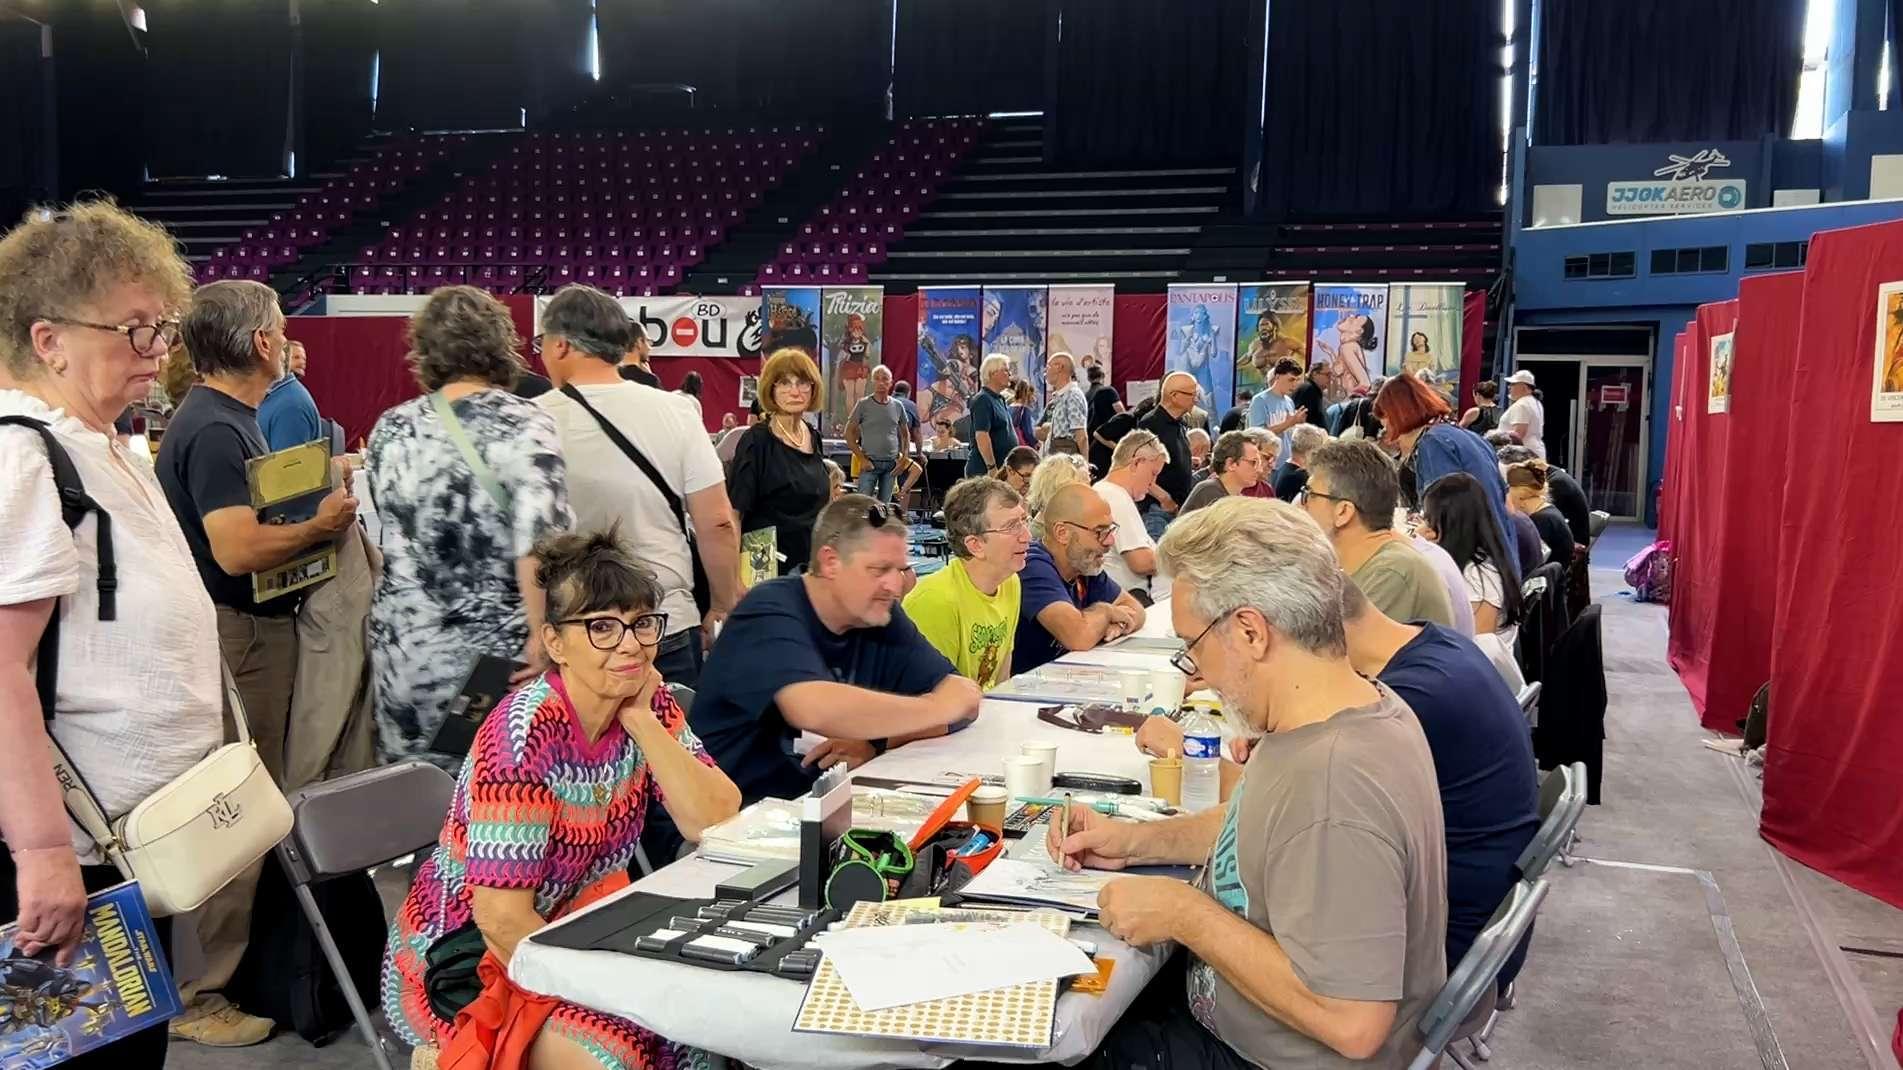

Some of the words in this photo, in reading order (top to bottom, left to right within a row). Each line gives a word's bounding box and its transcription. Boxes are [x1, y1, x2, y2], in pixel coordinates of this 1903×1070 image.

[1612, 202, 1665, 210] HELICOPTER
[1316, 293, 1353, 308] HONEY
[1357, 294, 1384, 309] TRAP
[697, 303, 721, 317] BD
[134, 929, 150, 952] STAR
[143, 949, 157, 973] WARS
[134, 947, 142, 960] THE
[88, 902, 153, 1018] MANDALORIAN
